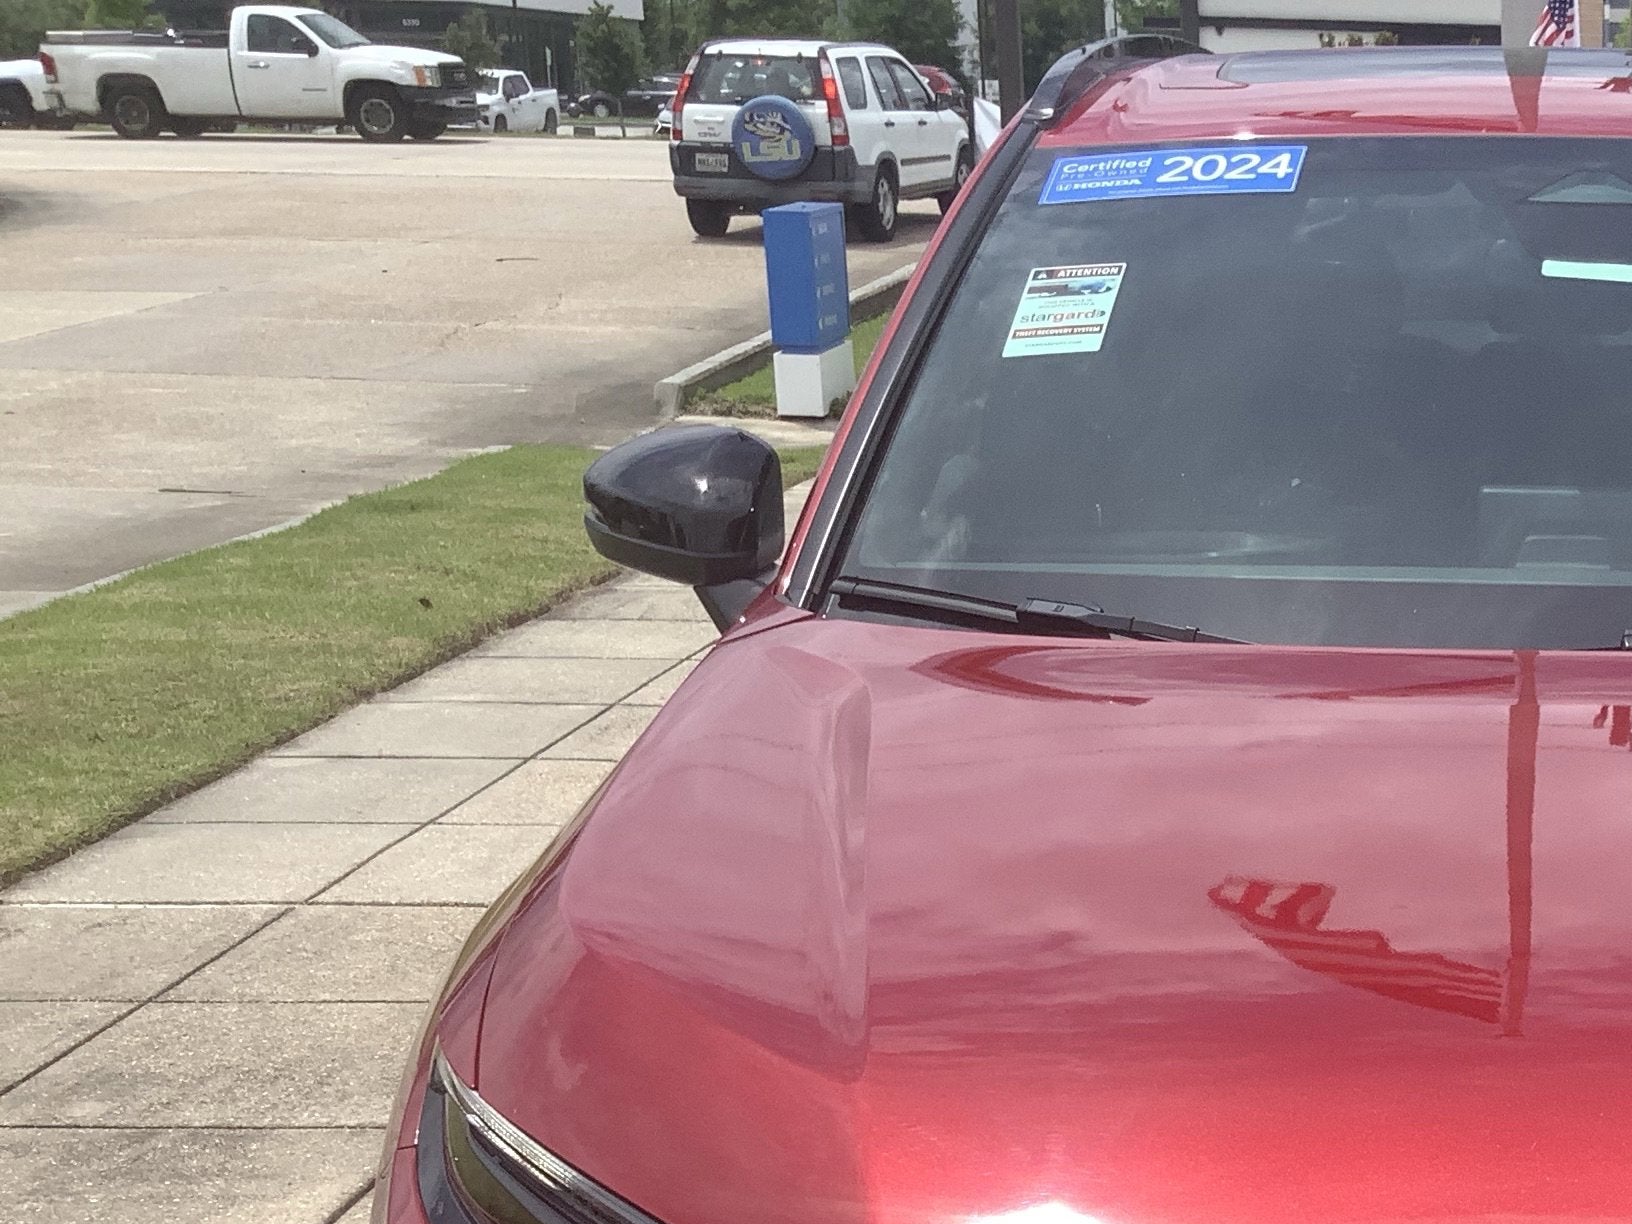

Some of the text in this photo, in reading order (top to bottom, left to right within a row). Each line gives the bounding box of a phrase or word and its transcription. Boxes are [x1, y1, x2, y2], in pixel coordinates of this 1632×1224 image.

[741, 138, 802, 163] LSU
[1060, 166, 1149, 180] Pre-Owned
[1063, 157, 1153, 175] Certified
[1156, 153, 1295, 184] 2024
[1072, 178, 1144, 191] HONDA
[1057, 266, 1120, 279] ATTENTION
[1014, 326, 1101, 338] THEFT RECOVERY SYSTEM
